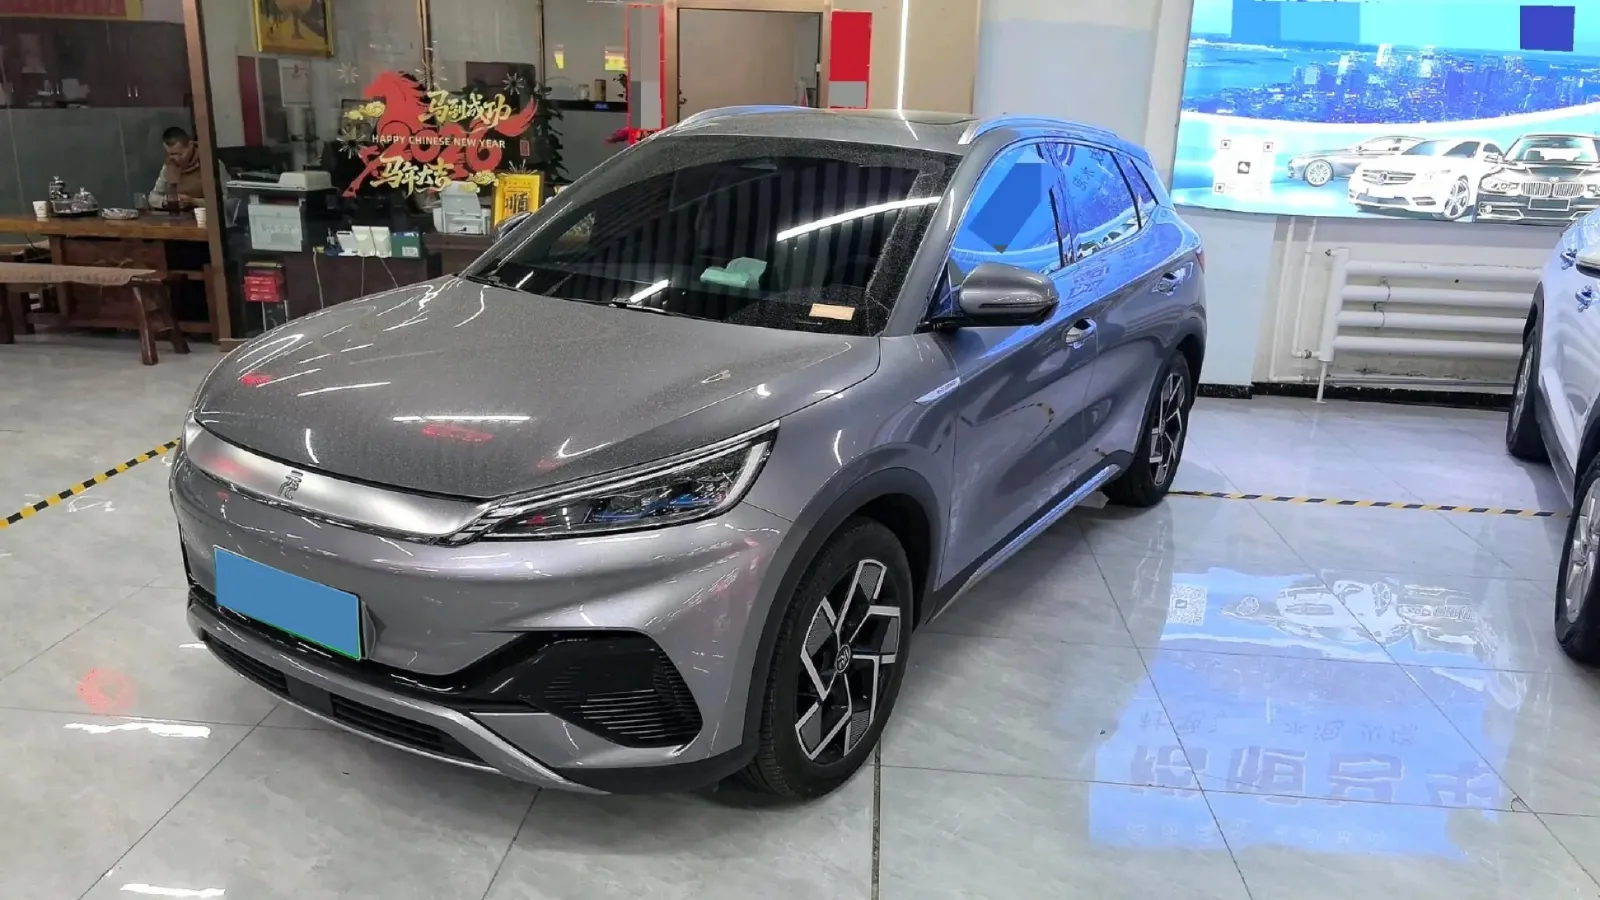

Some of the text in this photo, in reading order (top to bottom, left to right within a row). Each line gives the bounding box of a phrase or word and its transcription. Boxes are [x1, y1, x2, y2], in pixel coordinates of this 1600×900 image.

[417, 89, 511, 131] 马到成功
[372, 134, 506, 149] HAPPY CHINESE NEW YEAR
[370, 156, 454, 199] 马年大吉
